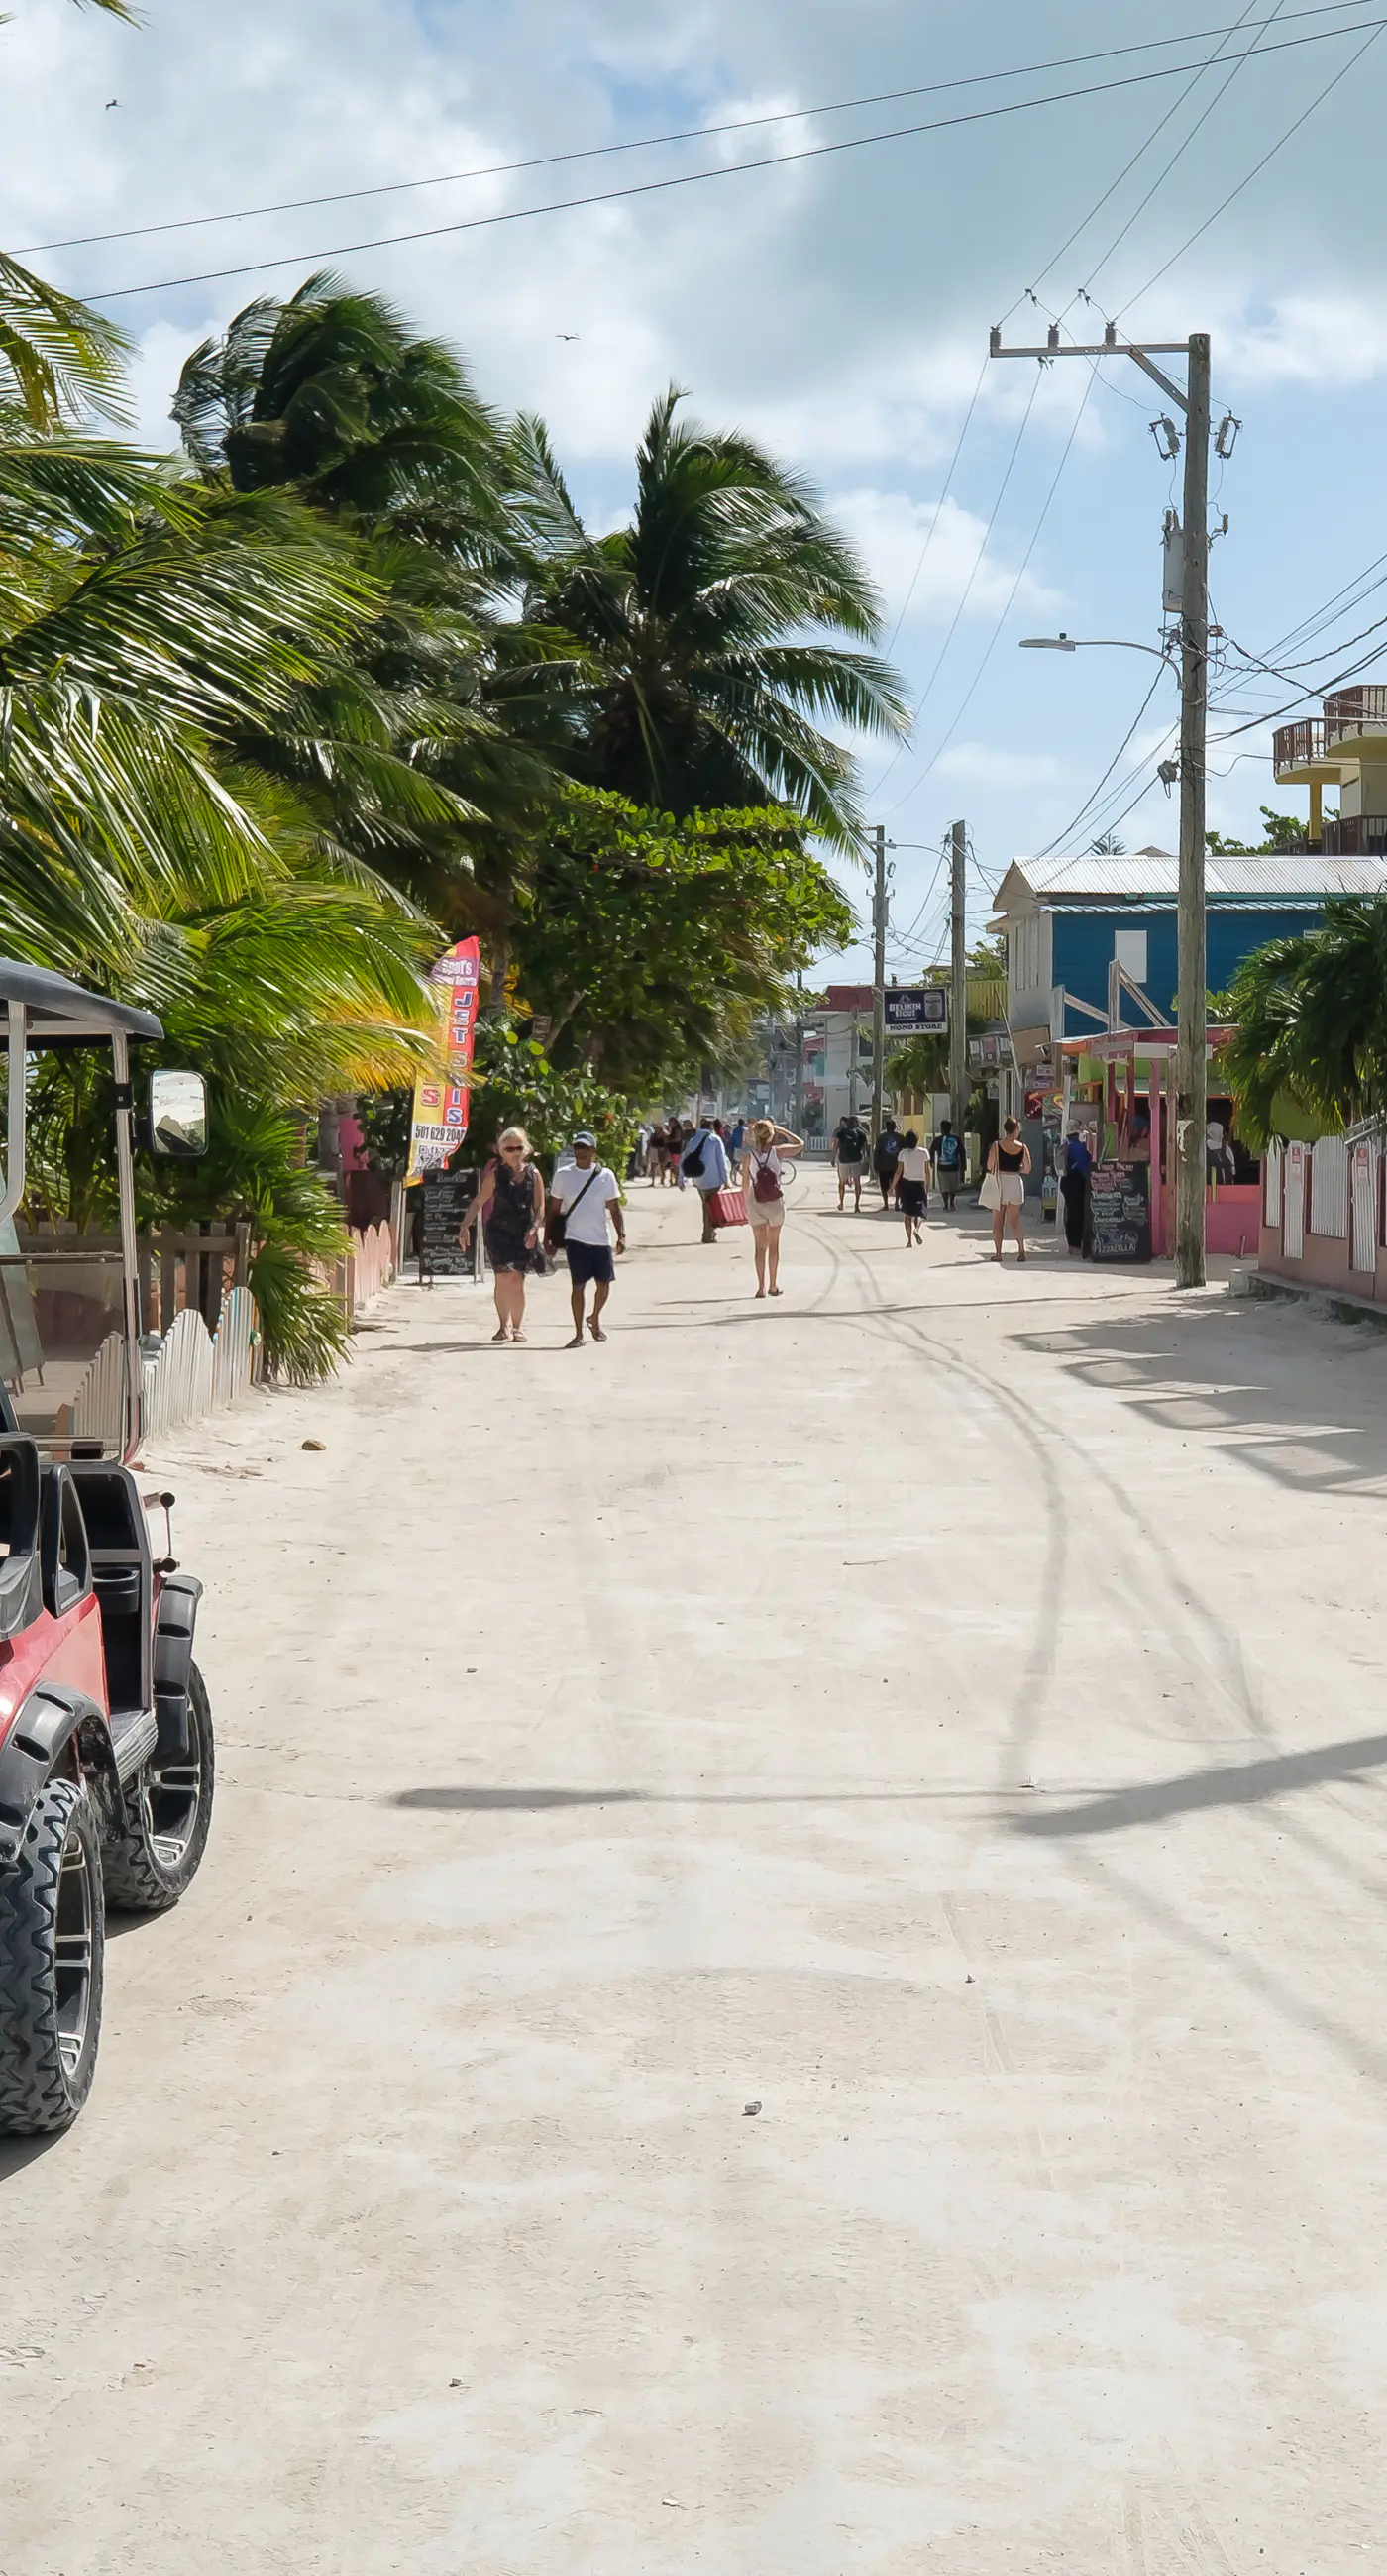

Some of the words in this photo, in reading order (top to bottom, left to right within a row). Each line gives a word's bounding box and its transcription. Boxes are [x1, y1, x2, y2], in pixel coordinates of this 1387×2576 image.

[453, 991, 473, 1044] JET
[446, 1050, 468, 1125] SIS
[415, 1125, 430, 1139] 501
